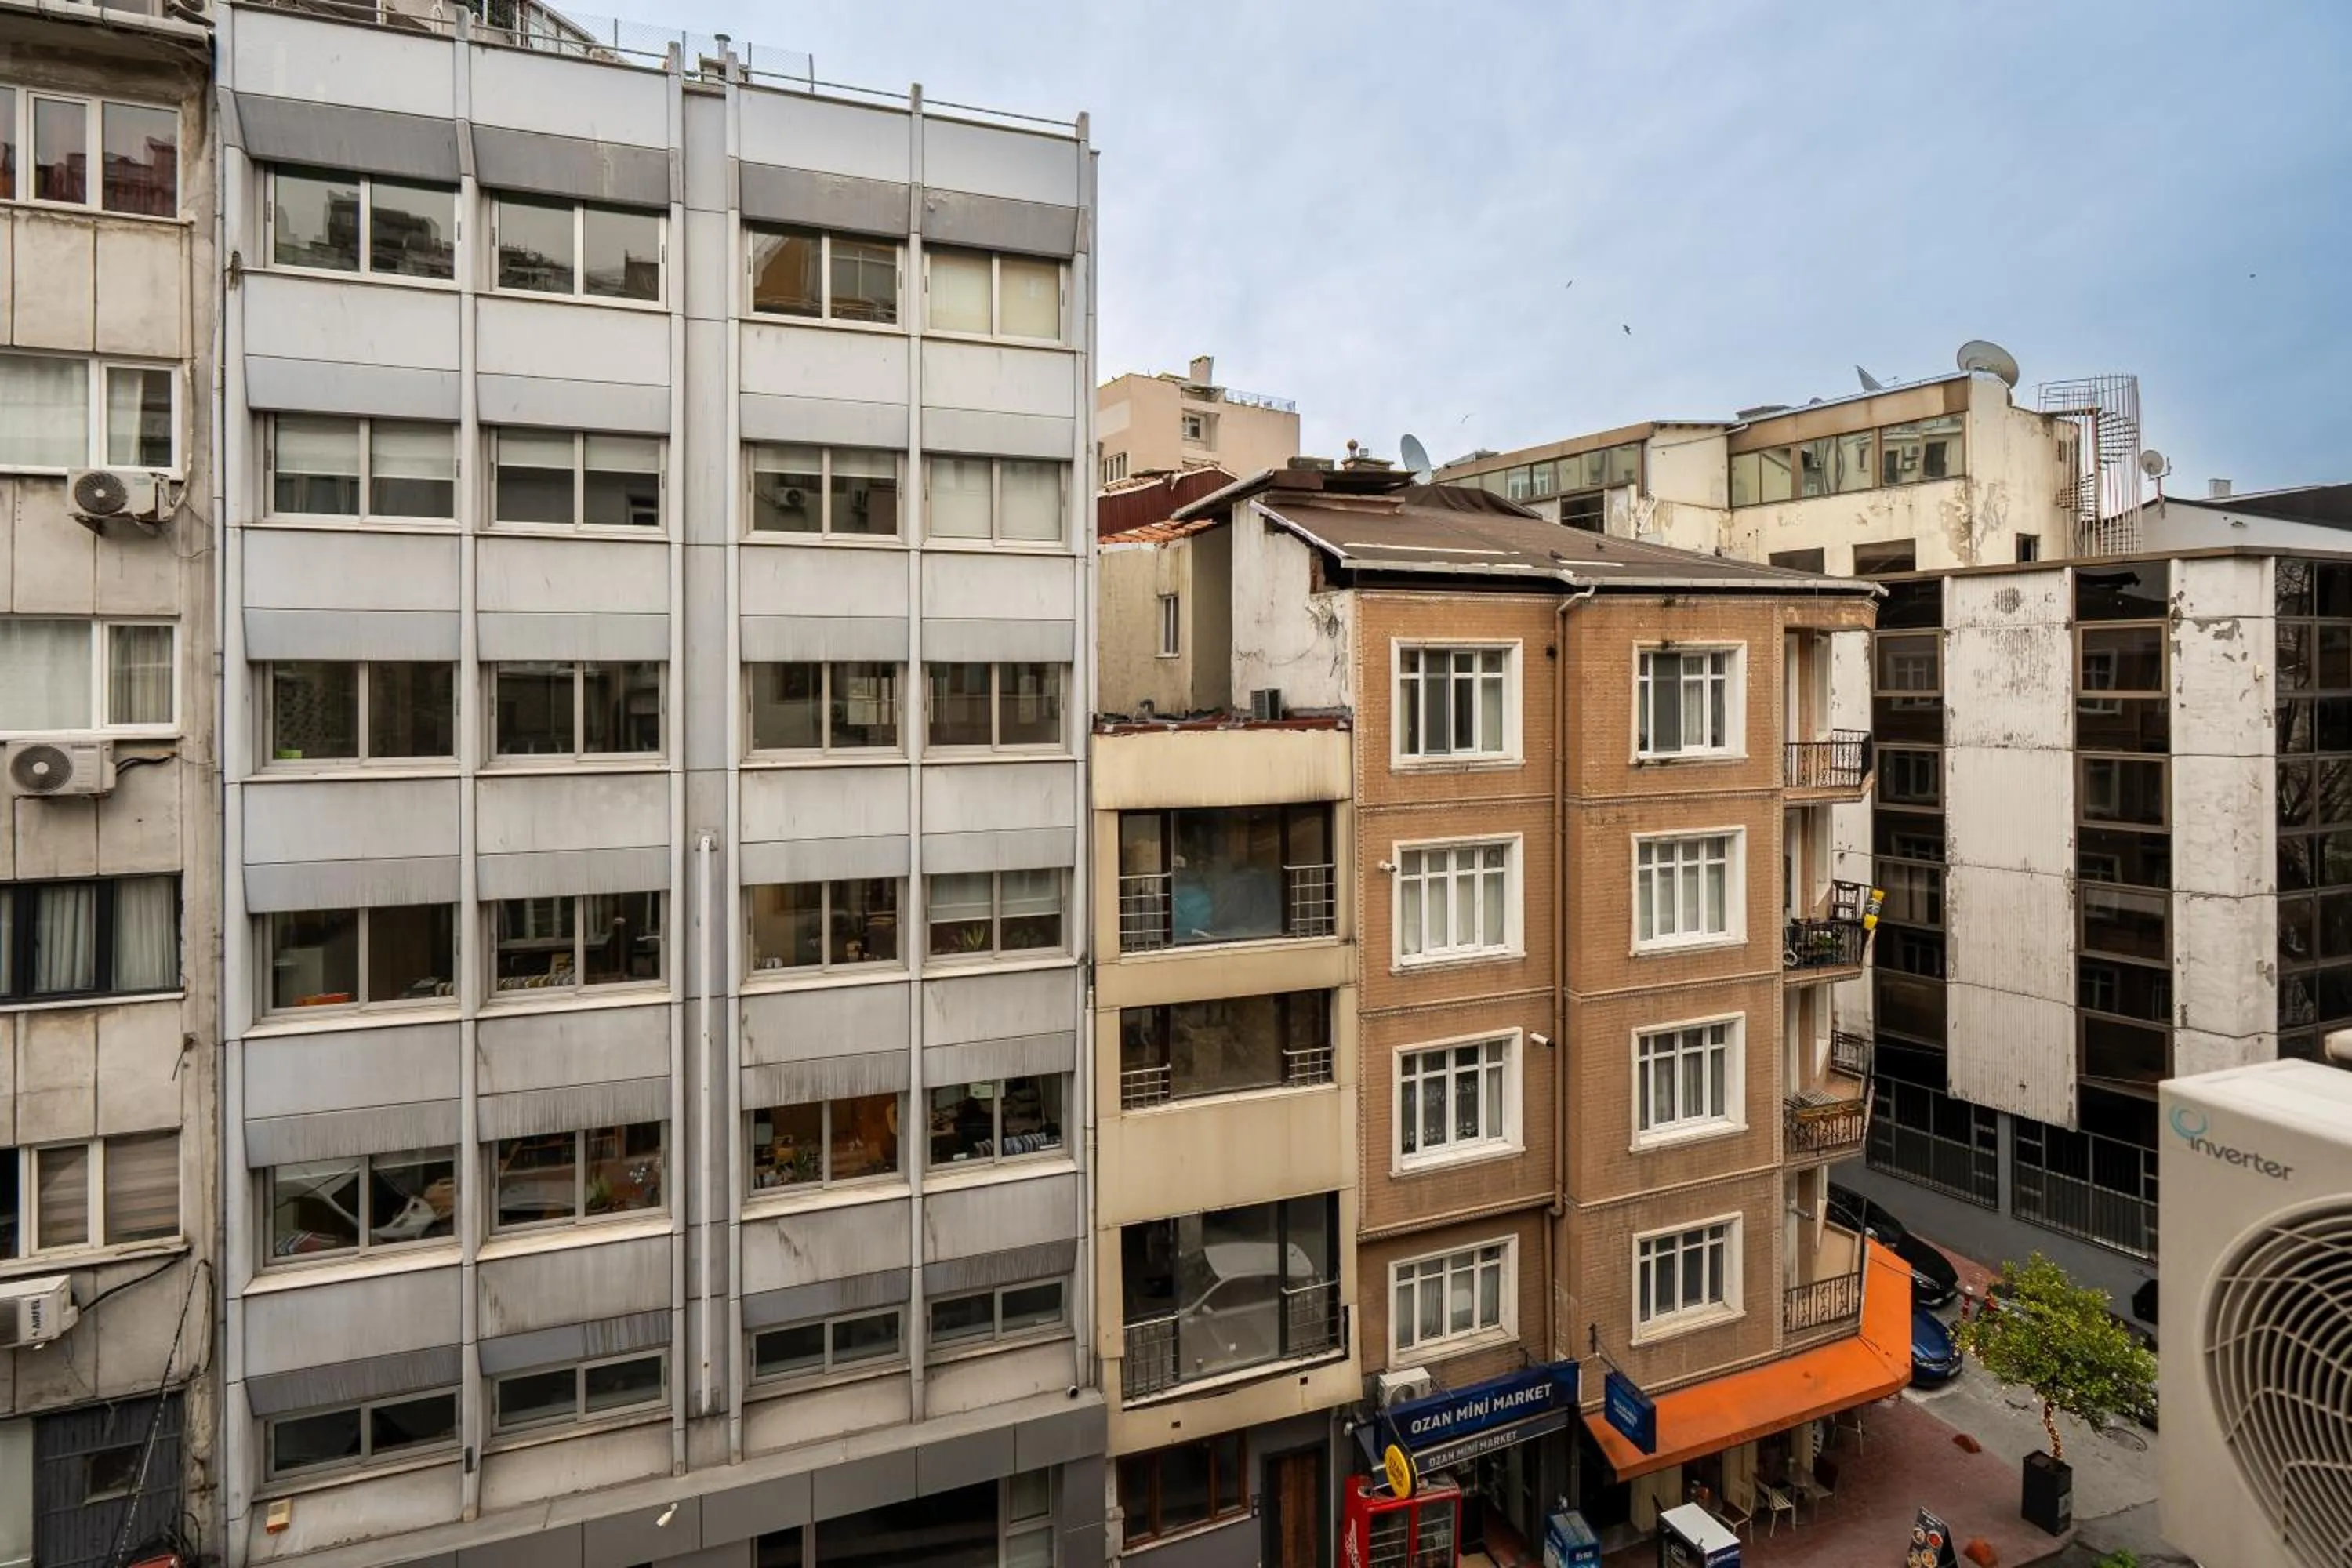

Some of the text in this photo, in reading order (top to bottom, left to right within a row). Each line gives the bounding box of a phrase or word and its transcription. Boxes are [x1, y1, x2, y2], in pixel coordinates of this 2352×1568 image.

[2190, 1136, 2294, 1180] inverter
[1411, 1382, 1552, 1434] OZAN MİNİ MARKET
[1429, 1451, 1454, 1467] OZAN
[1479, 1429, 1518, 1450] MARKET
